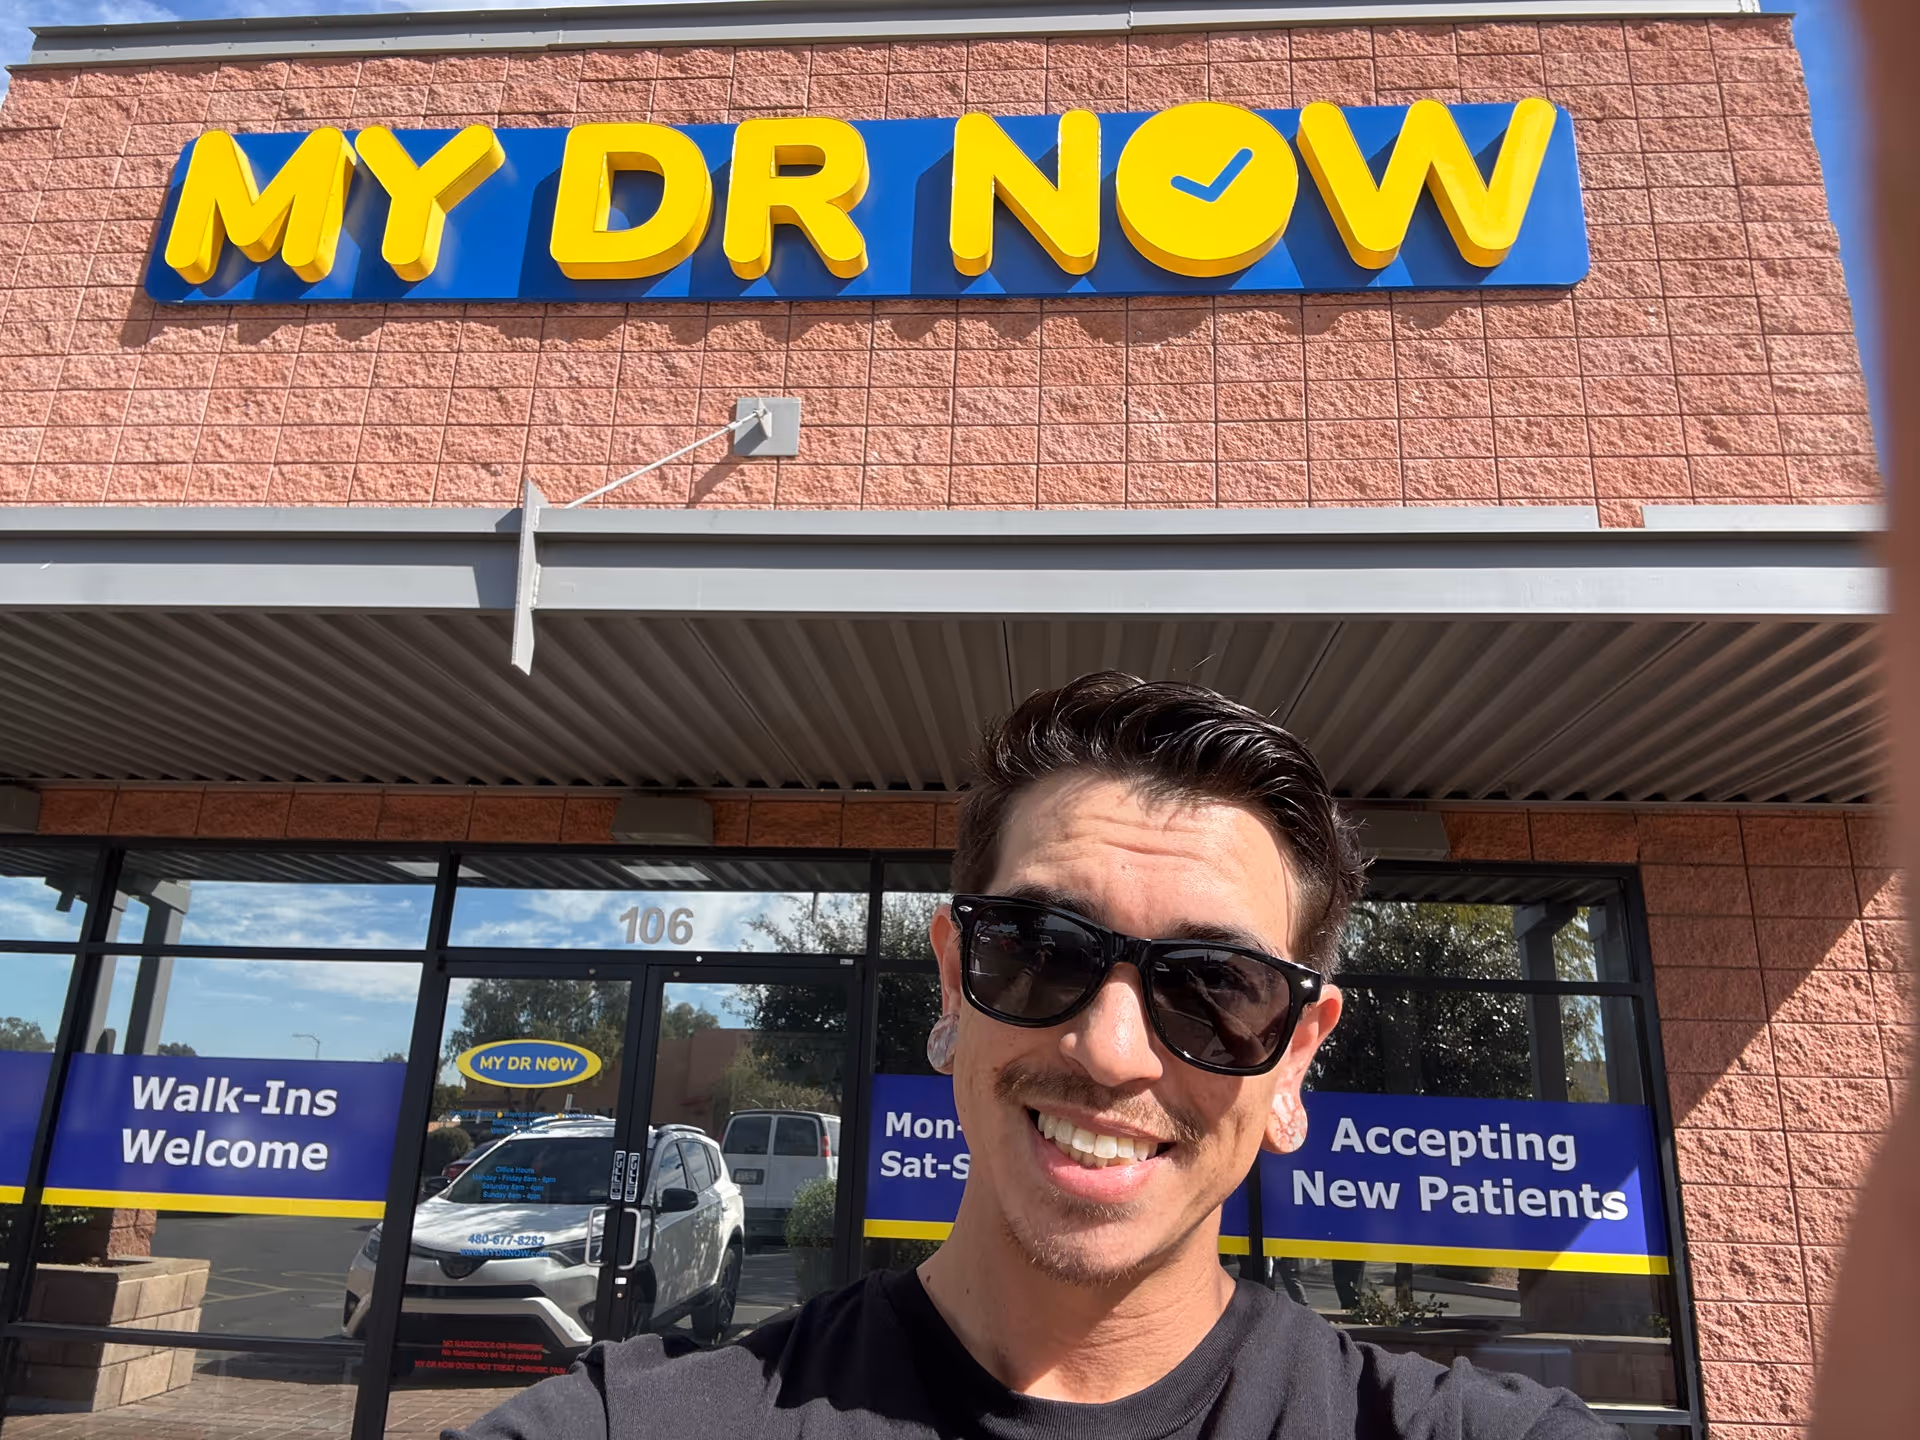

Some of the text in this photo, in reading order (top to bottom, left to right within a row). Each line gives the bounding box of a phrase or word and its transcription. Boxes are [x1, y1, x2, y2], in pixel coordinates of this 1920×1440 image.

[164, 97, 1557, 285] MY DR NOW
[619, 906, 694, 945] 106
[480, 1056, 578, 1072] MY DR NOW
[132, 1075, 338, 1117] Walk-Ins
[122, 1128, 329, 1171] Welcome
[1331, 1117, 1577, 1172] Accepting
[614, 1153, 623, 1183] PULL
[629, 1155, 638, 1185] PULL
[1292, 1170, 1629, 1221] New Patients
[468, 1233, 545, 1247] 480-677-8282
